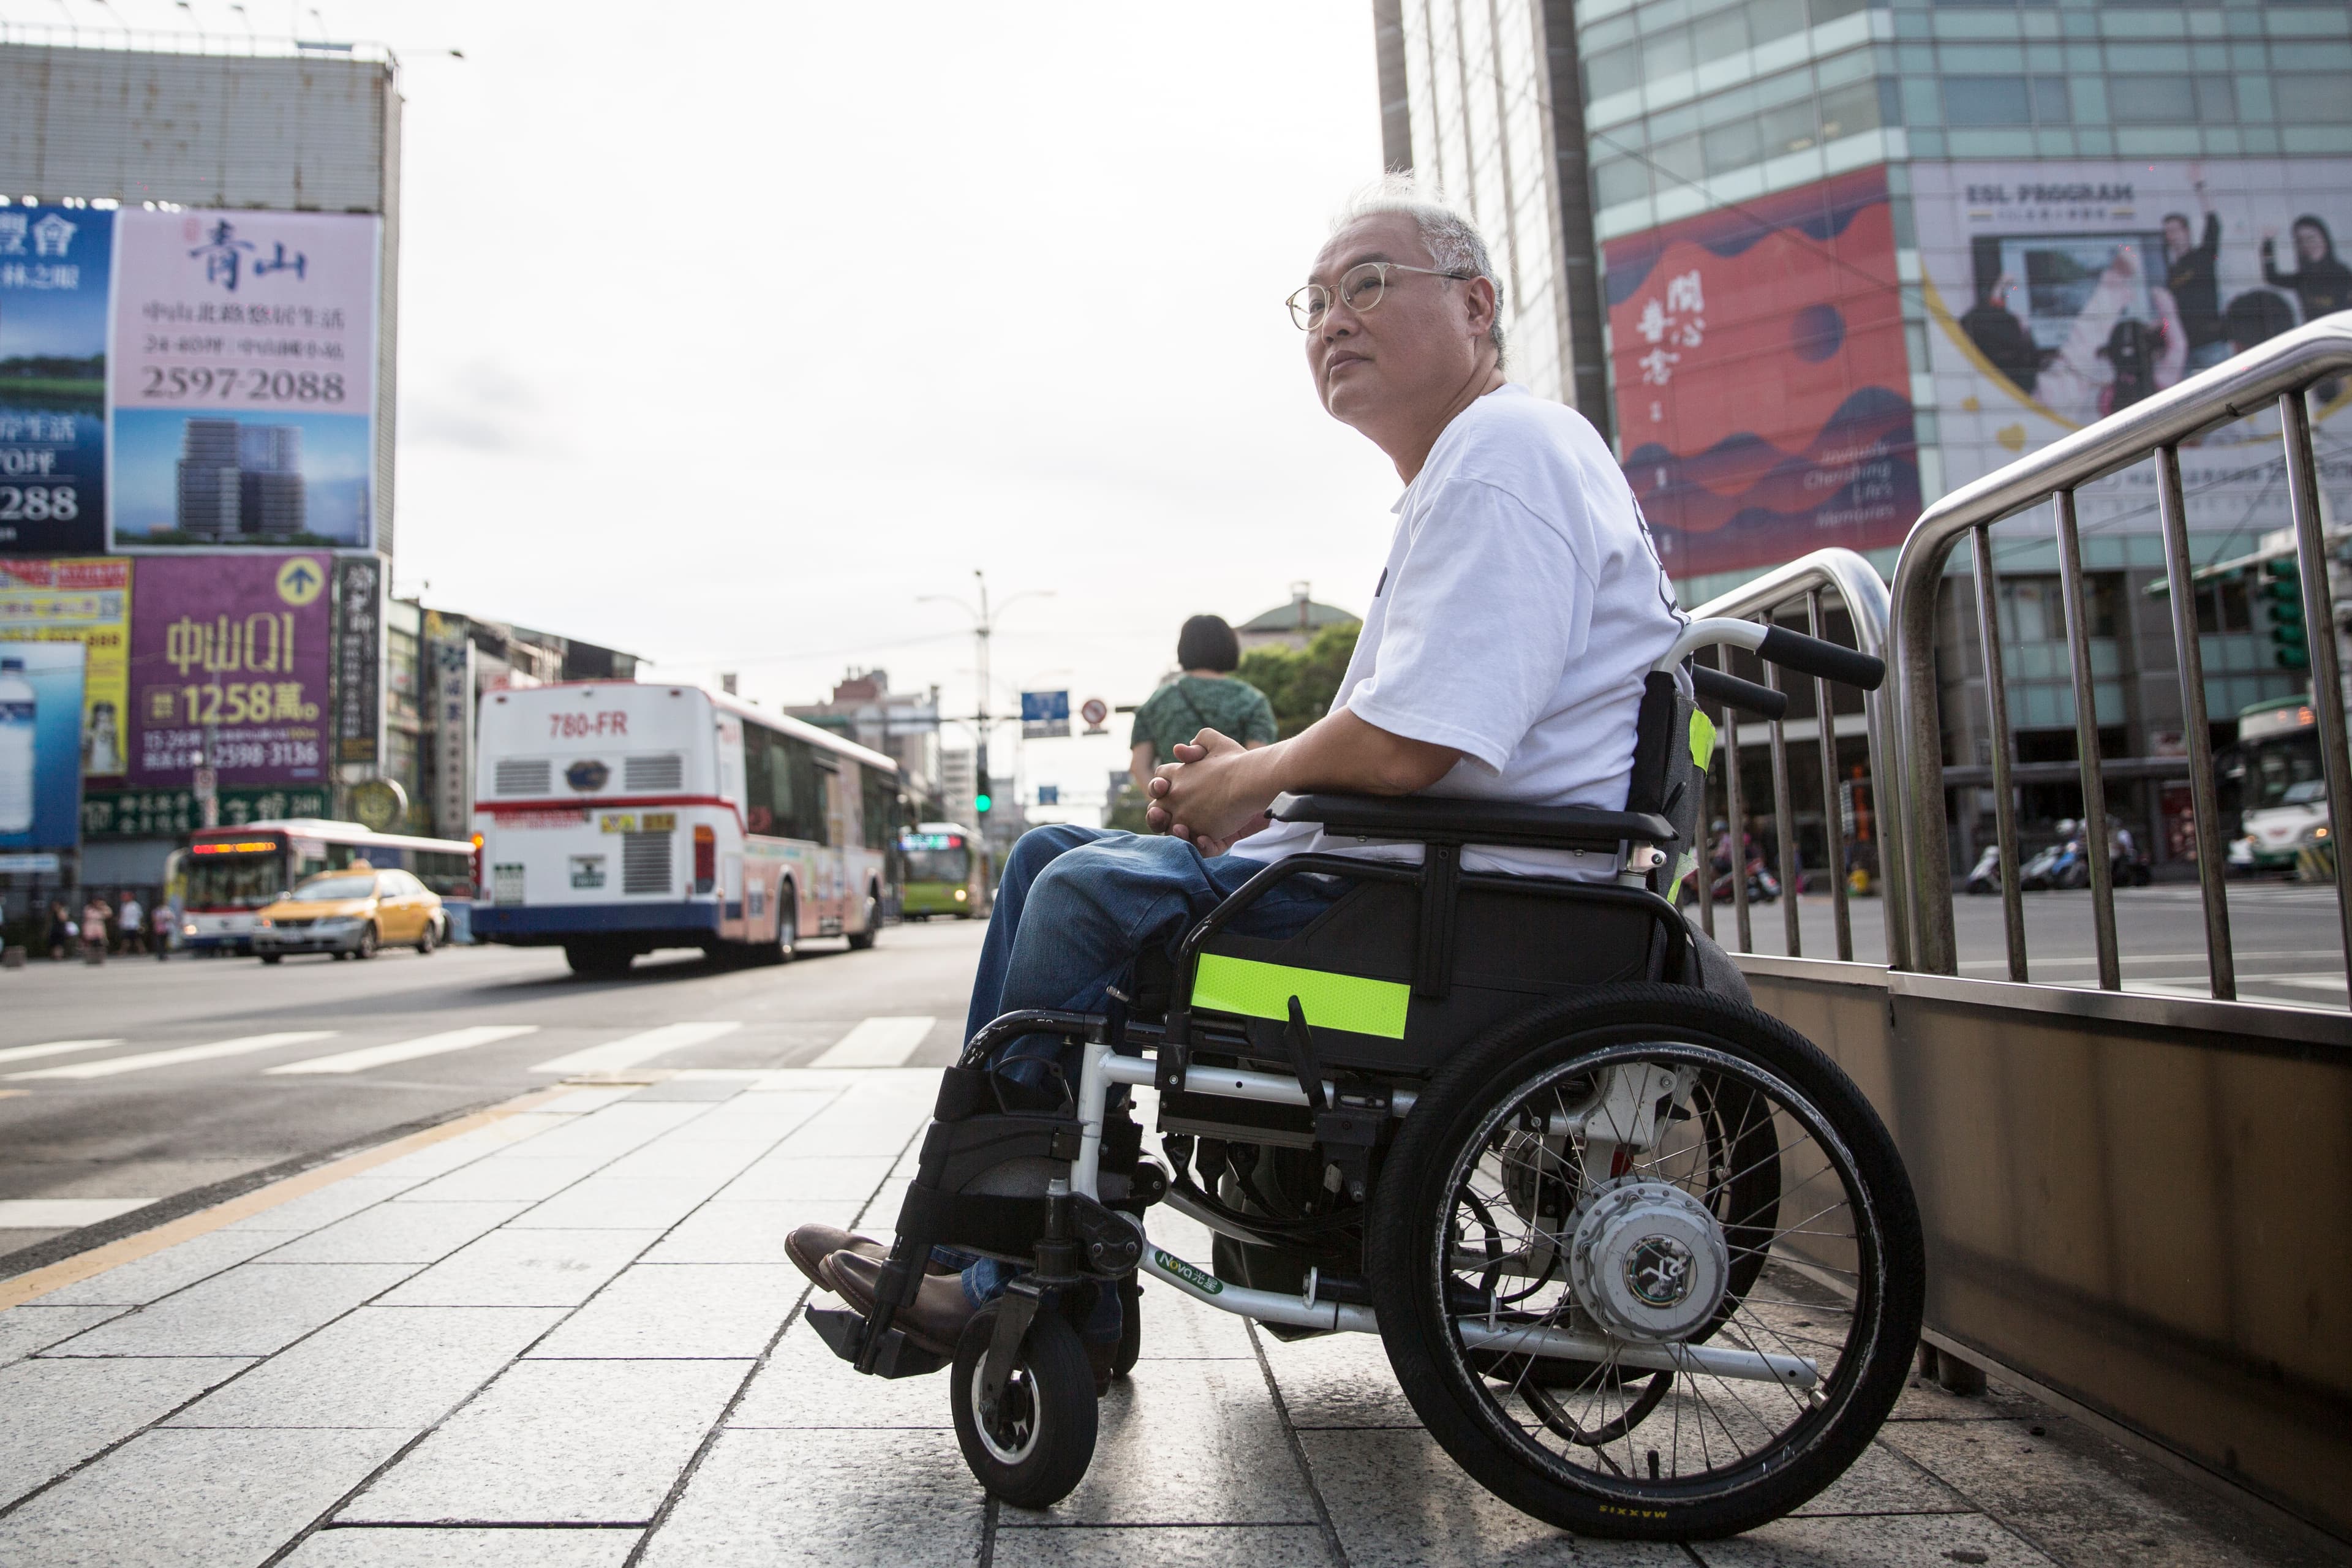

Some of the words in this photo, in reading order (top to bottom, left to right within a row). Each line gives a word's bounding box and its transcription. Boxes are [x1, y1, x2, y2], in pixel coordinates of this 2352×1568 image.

[1966, 183, 2009, 204] ESL
[2017, 182, 2134, 205] PROGRAM
[187, 219, 307, 292] 青山
[140, 366, 347, 404] 2597-2088
[549, 710, 628, 739] 780-FR
[1159, 1253, 1193, 1279] Nova
[1194, 1271, 1218, 1292] 光星
[1599, 1505, 1668, 1519] MAXXIS
